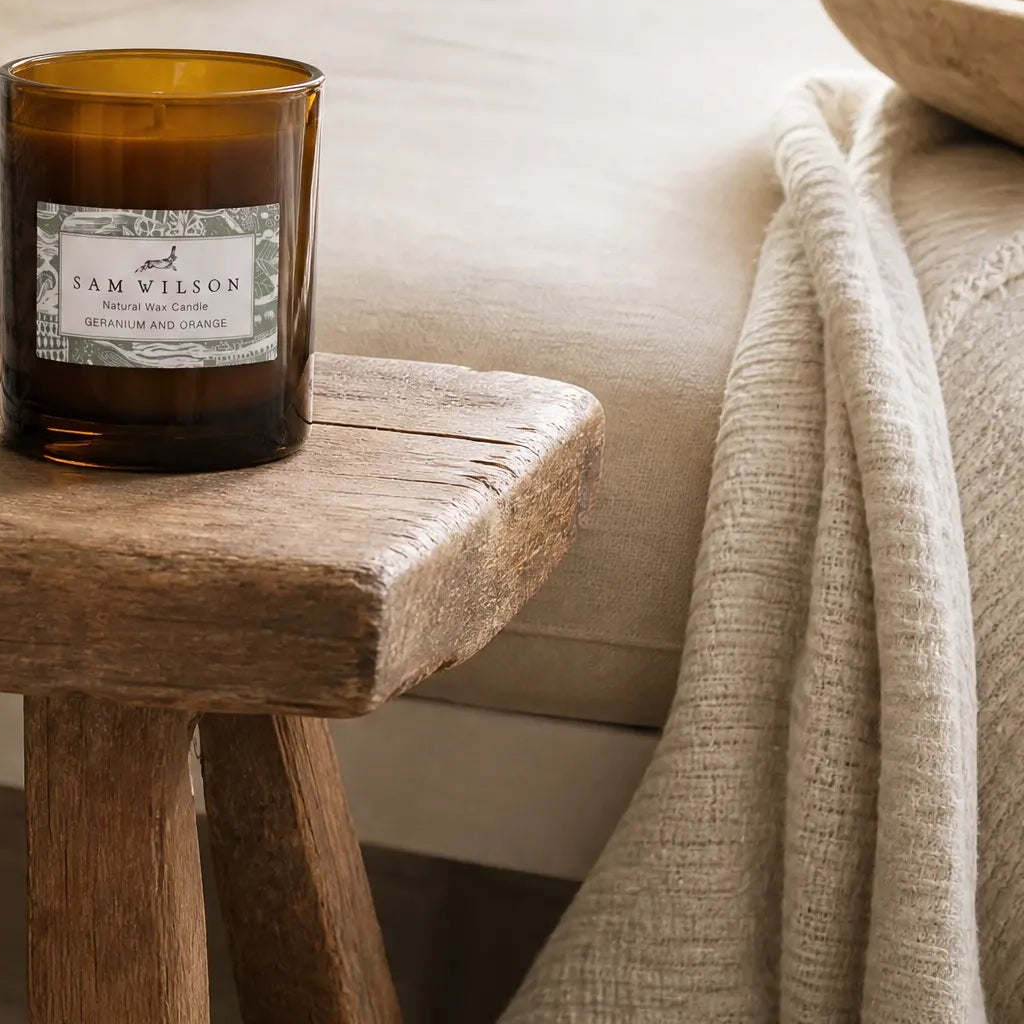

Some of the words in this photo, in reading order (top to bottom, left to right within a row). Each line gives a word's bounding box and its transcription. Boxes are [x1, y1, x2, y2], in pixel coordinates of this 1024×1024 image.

[72, 275, 124, 294] SAM
[137, 277, 239, 295] WILSON
[102, 300, 141, 312] Natural
[144, 302, 167, 312] Wax
[171, 301, 209, 312] Candle
[84, 316, 146, 330] GERANIUM
[149, 320, 175, 330] AND
[179, 318, 227, 330] ORANGE
